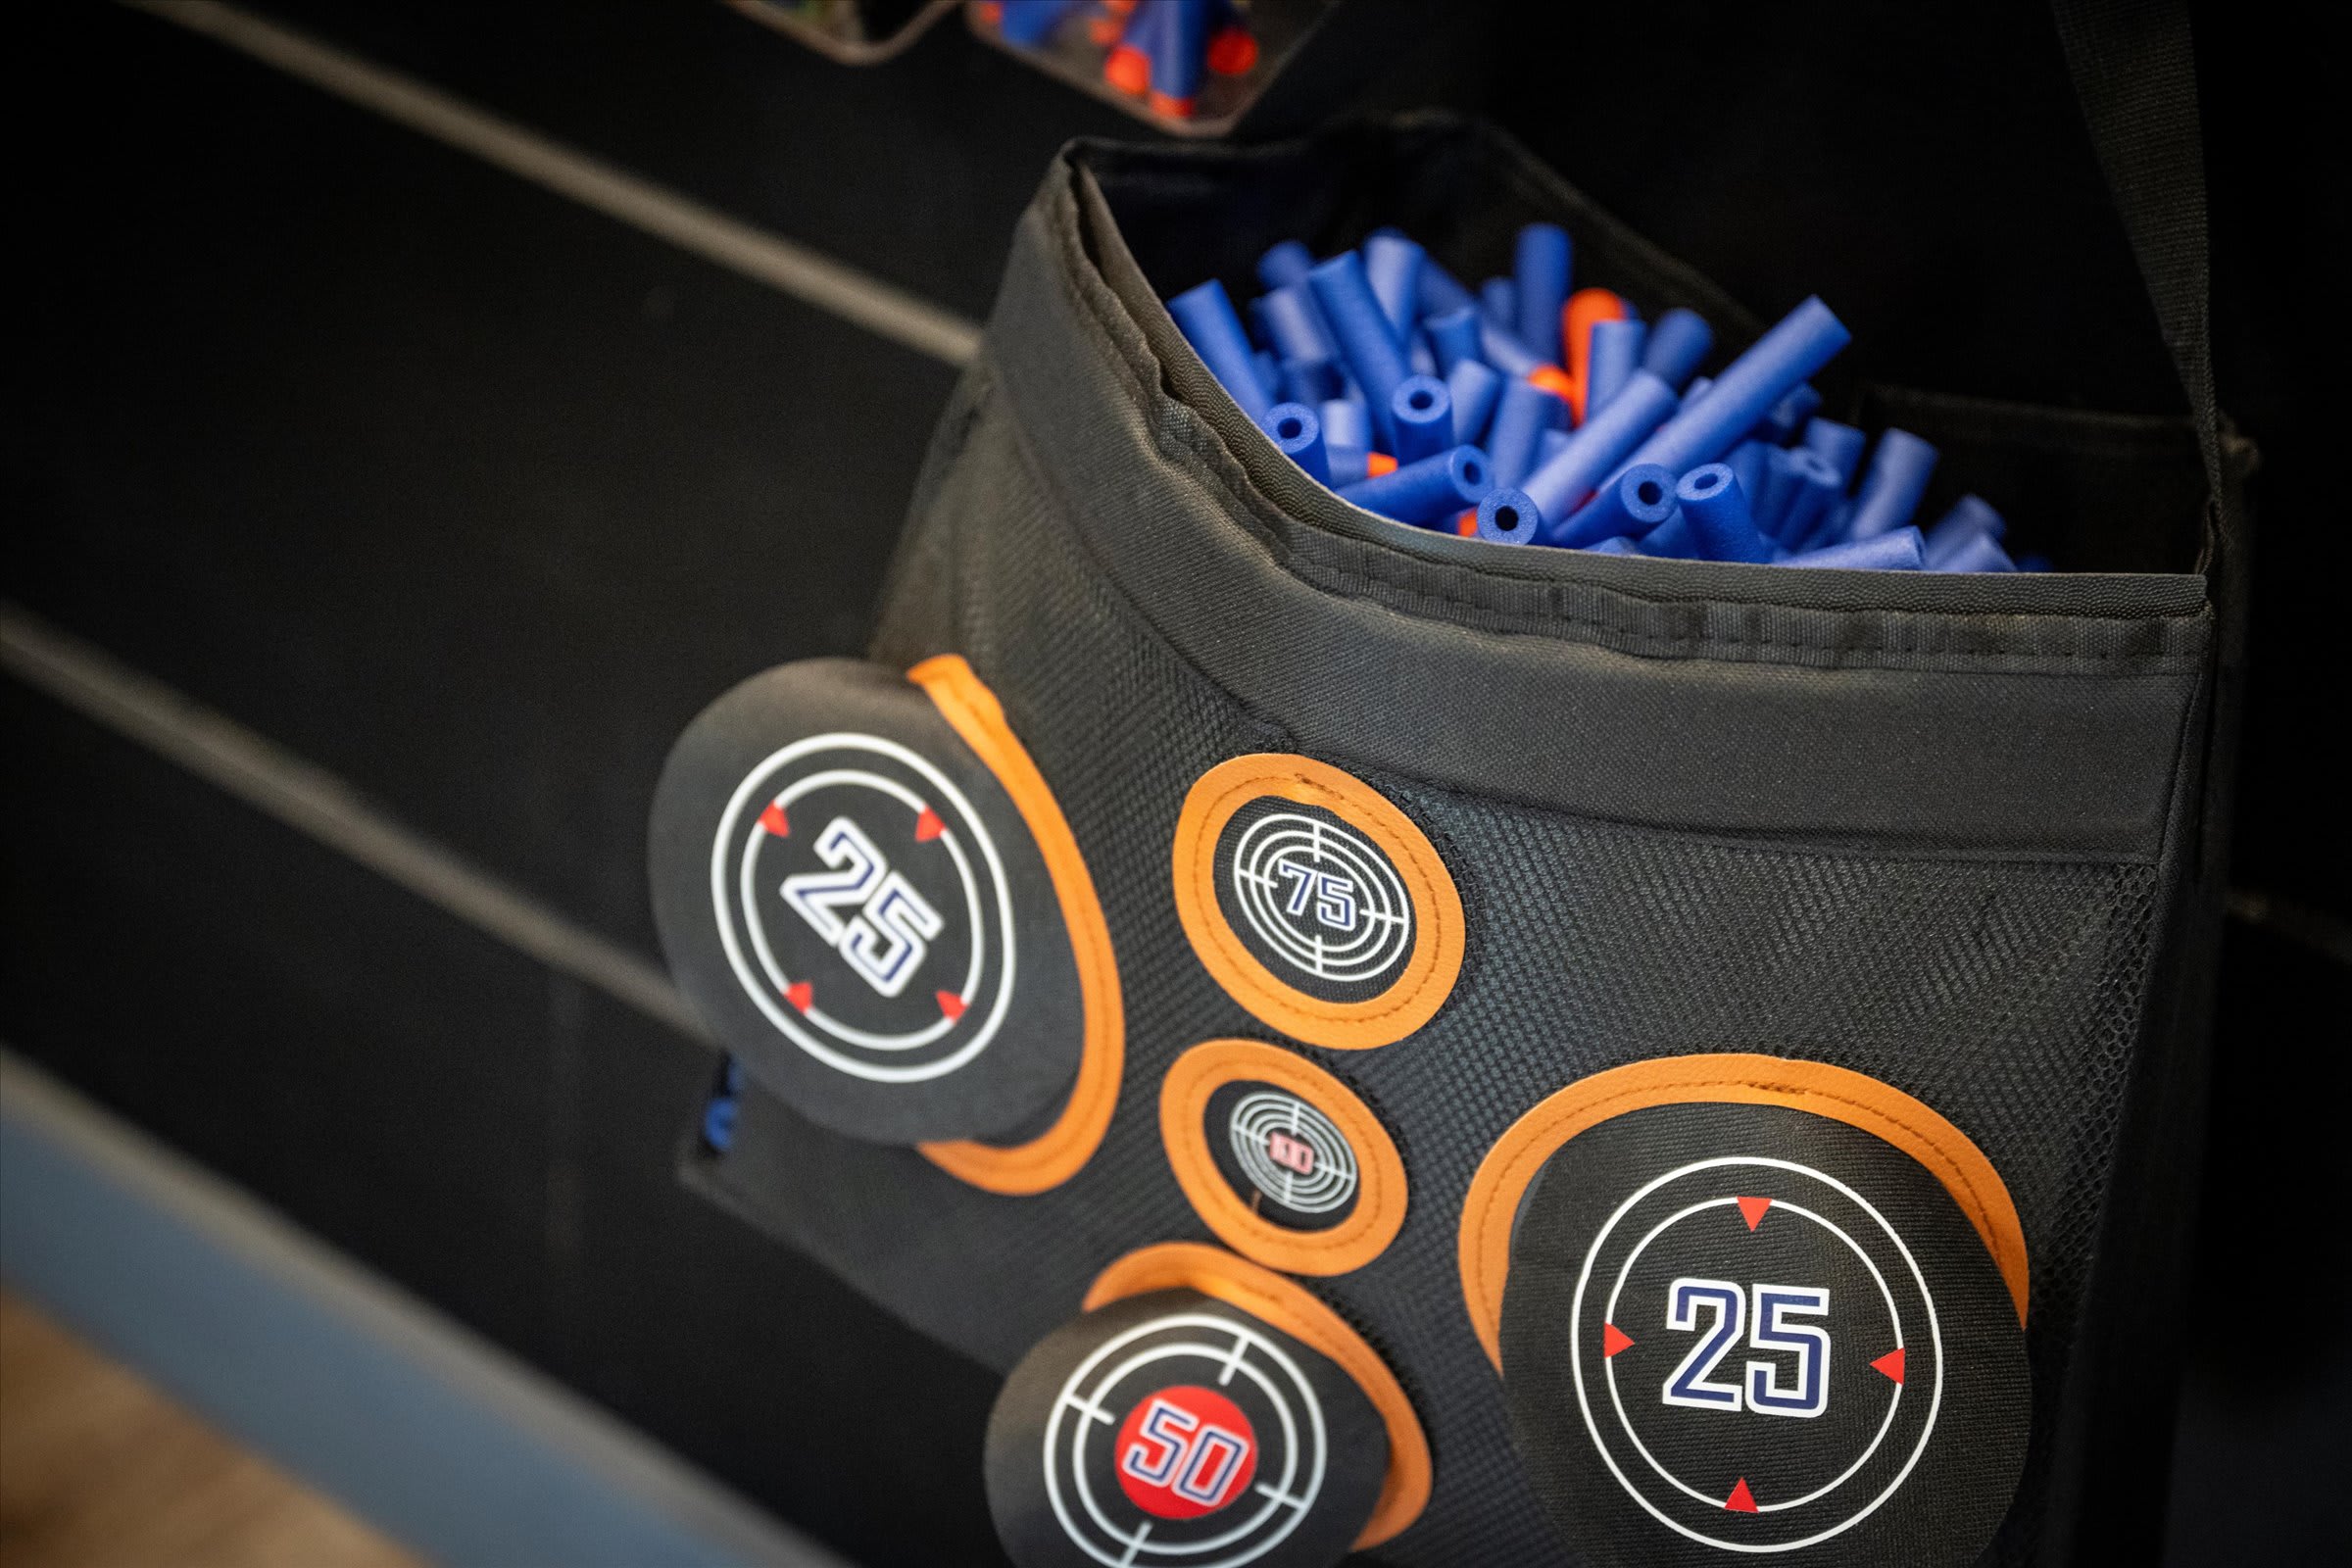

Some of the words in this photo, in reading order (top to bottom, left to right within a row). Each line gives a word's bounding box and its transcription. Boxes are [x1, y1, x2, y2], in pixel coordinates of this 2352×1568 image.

[780, 816, 944, 997] 25
[1278, 858, 1356, 931] 75
[1662, 1277, 1831, 1418] 25
[1122, 1398, 1250, 1507] 50
